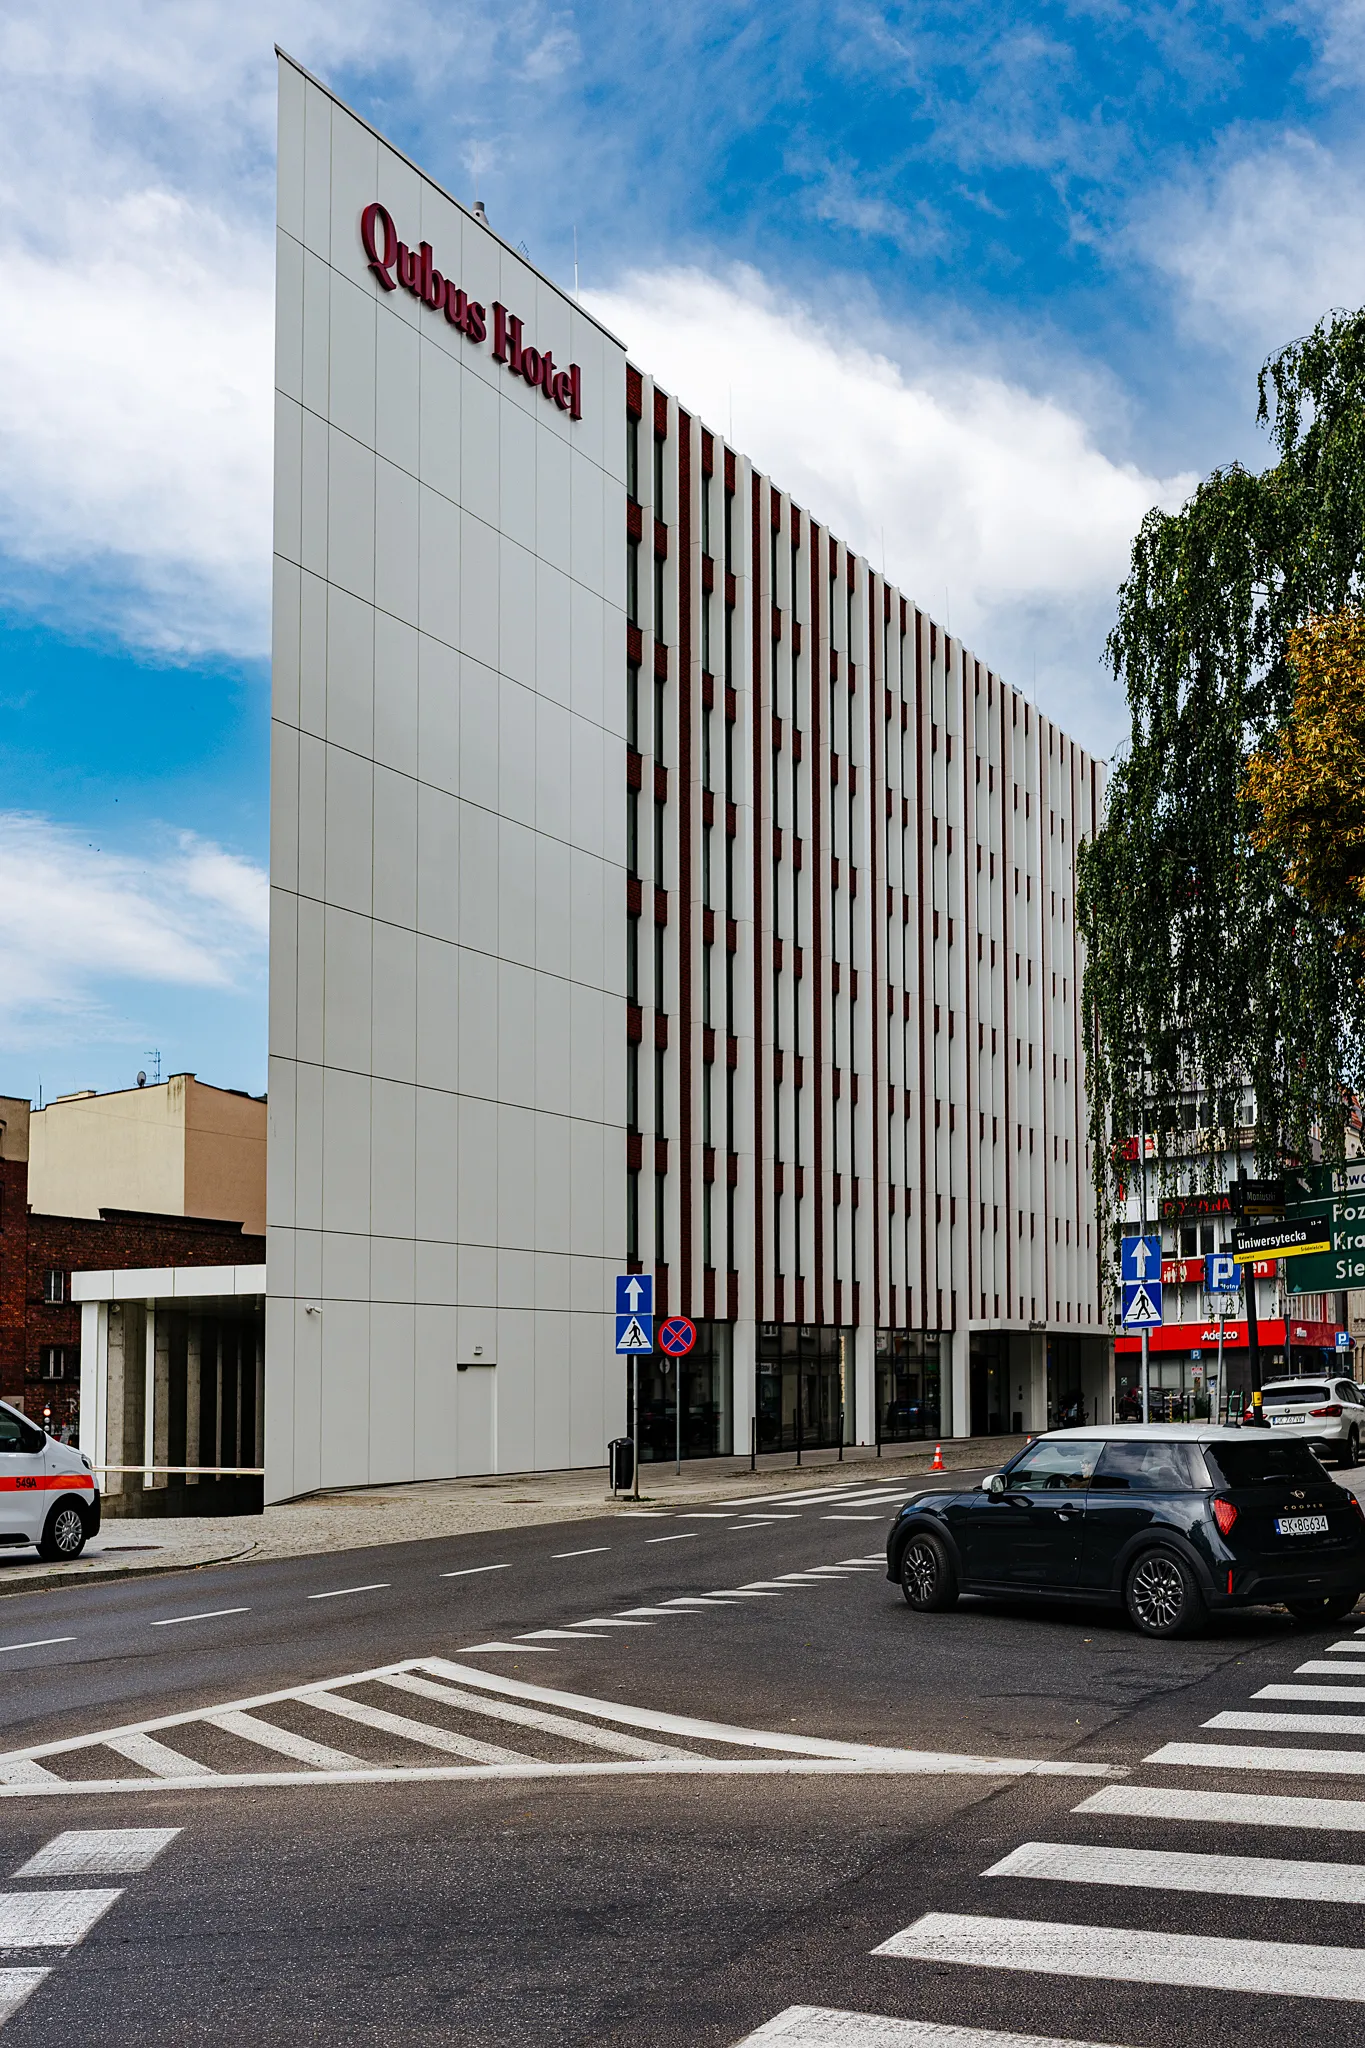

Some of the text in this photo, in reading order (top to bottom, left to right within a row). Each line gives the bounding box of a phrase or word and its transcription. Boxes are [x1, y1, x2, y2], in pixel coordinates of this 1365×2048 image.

[361, 202, 582, 420] Qubus Hotel
[1246, 1190, 1276, 1201] Moniuszki
[1237, 1230, 1307, 1250] Uniwersytecka
[1335, 1258, 1365, 1279] Sie
[1200, 1329, 1238, 1341] Adecco
[15, 1477, 37, 1488] 549A
[1283, 1503, 1324, 1511] COOPER
